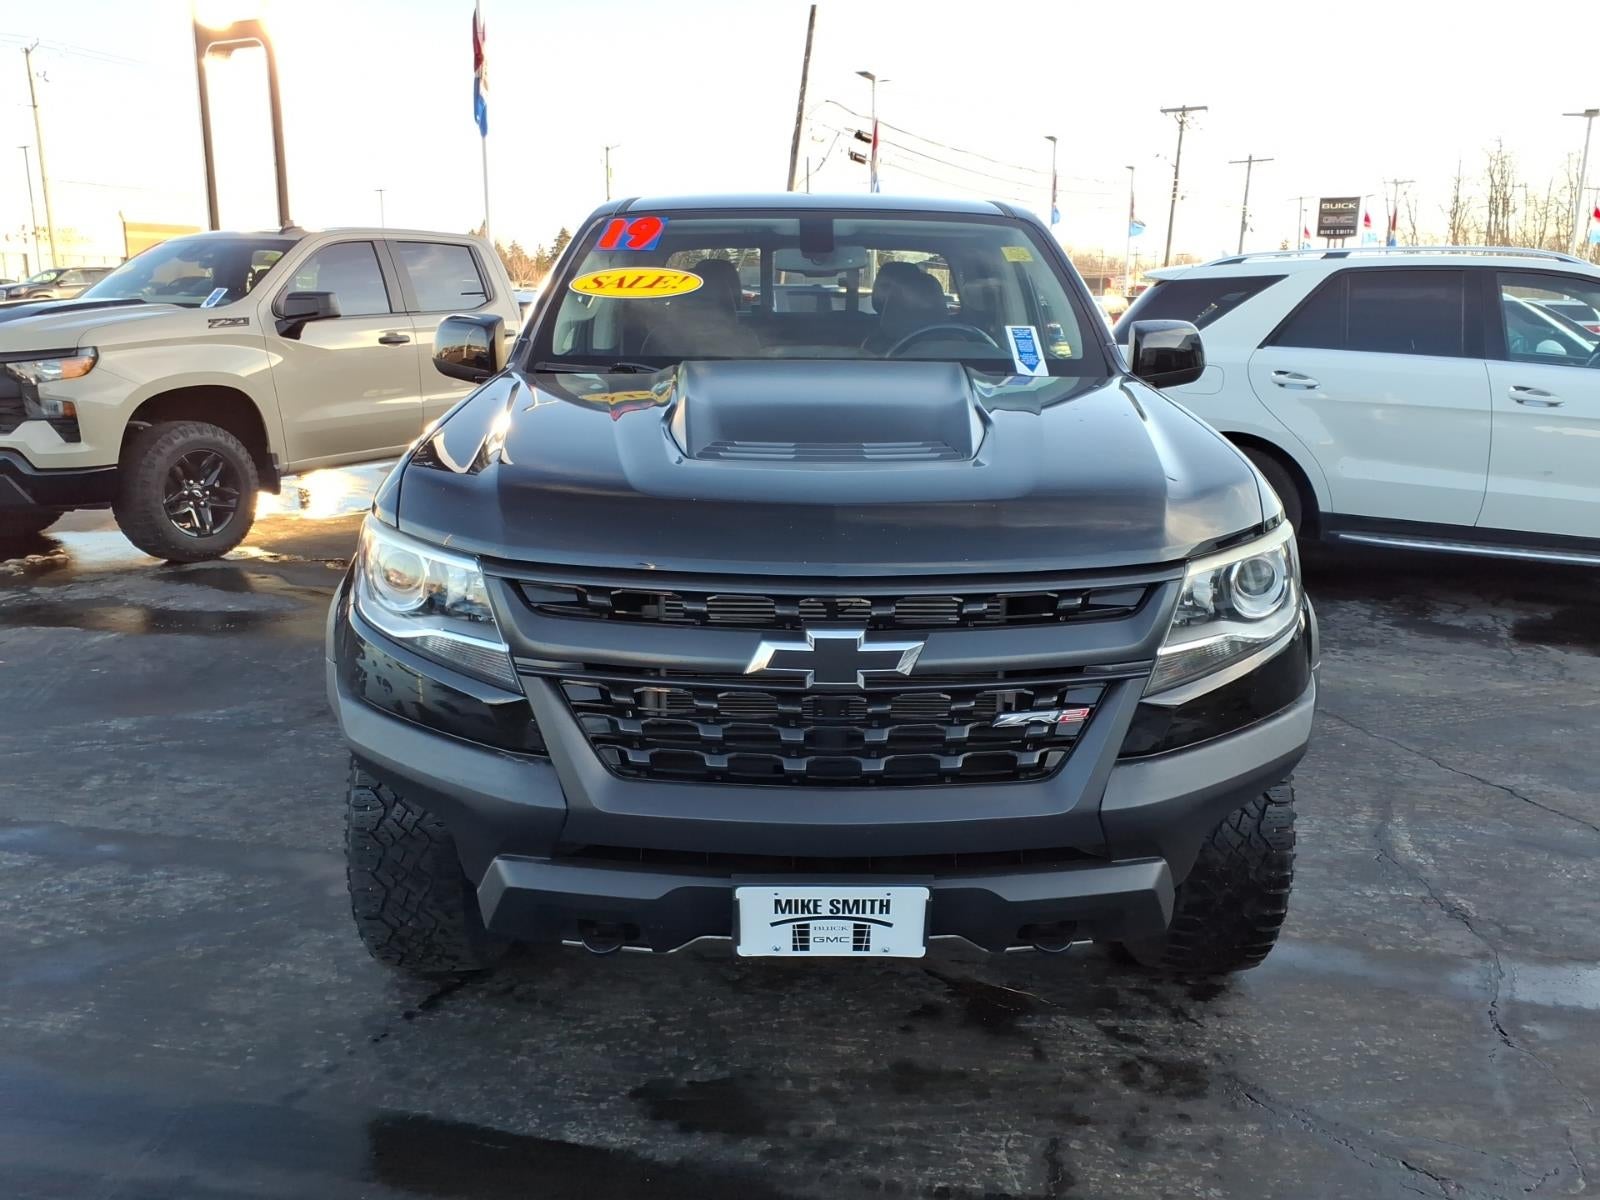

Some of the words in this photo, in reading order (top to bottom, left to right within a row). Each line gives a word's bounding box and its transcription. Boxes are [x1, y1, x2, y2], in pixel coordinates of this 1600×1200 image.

[597, 216, 664, 250] 19
[582, 275, 691, 290] SALE!
[992, 708, 1091, 728] ZR2
[774, 899, 822, 914] MIKE
[829, 899, 891, 914] SMITH
